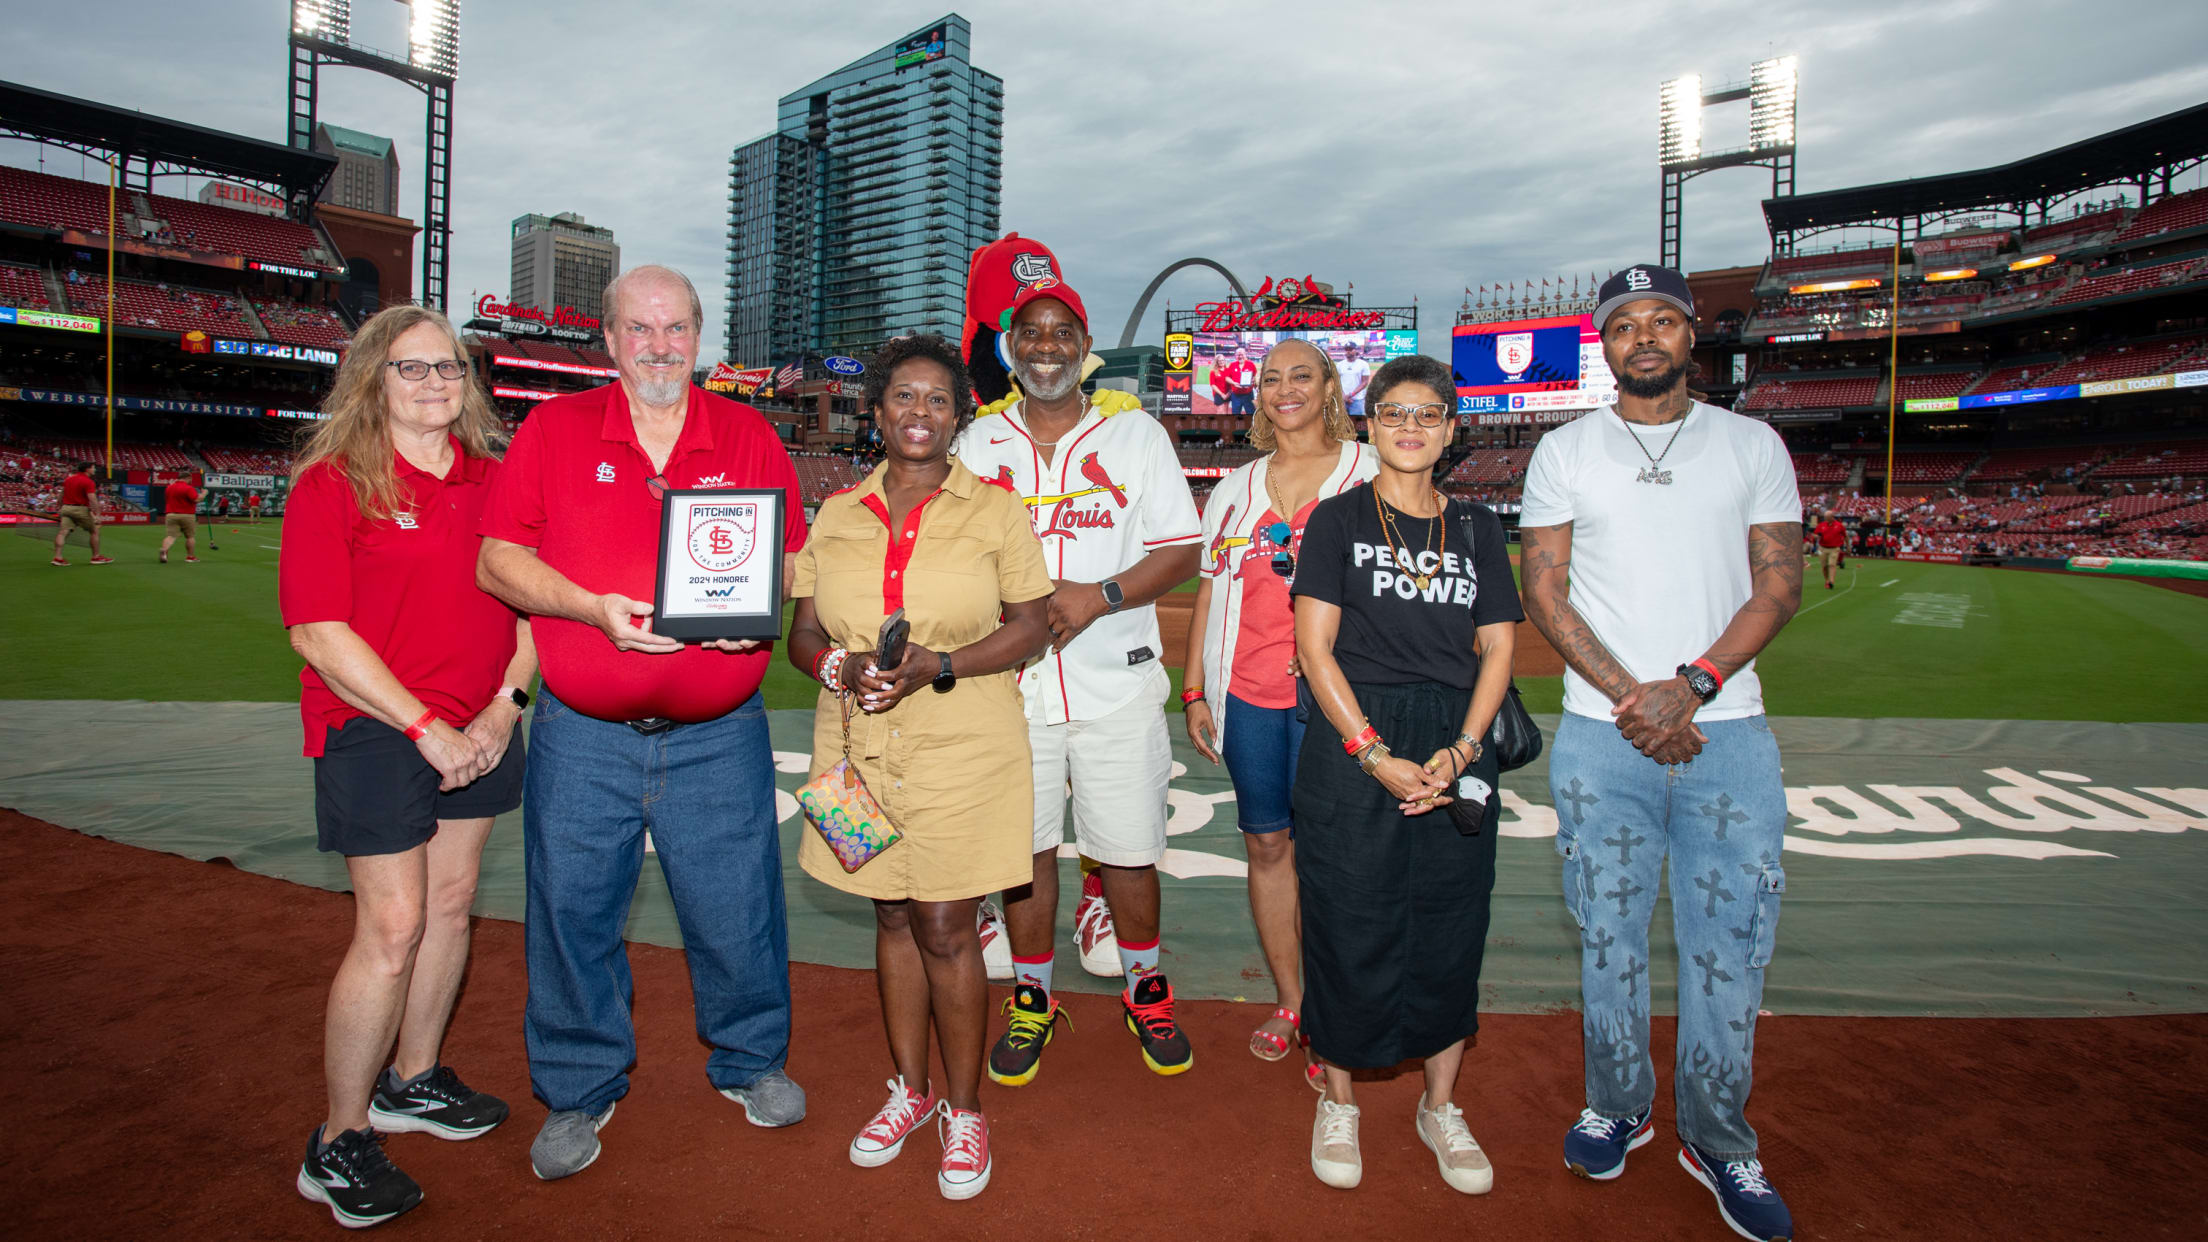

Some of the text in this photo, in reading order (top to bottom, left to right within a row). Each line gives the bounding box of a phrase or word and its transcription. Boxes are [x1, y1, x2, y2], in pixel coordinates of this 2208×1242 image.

[215, 183, 285, 210] Hilton
[1944, 214, 1997, 225] BUDWEISER
[1949, 235, 2005, 247] BUDWEISER
[260, 263, 318, 278] FOR THE LOU
[478, 294, 600, 329] Cardinals Nation
[1195, 301, 1385, 332] Budweiser
[1472, 299, 1599, 321] WORLD CHAMPIO
[501, 320, 540, 333] HOFFMANN
[552, 328, 590, 340] ROOFTOP
[1791, 334, 1807, 342] THE
[214, 340, 339, 365] BIG MAC LAND
[833, 358, 857, 371] Ford
[707, 366, 766, 383] Budweis
[704, 380, 774, 398] BREW HOE
[2083, 381, 2124, 394] ENROLL
[2126, 377, 2167, 390] TODAY!
[140, 399, 257, 416] UNIVERSITY
[1462, 395, 1499, 409] STIFEL
[277, 409, 296, 418] FOR
[297, 411, 316, 419] THE
[1479, 413, 1521, 425] BROWN
[1524, 415, 1532, 423] &
[221, 475, 273, 488] Ballpark
[693, 507, 743, 517] PITCHING
[1040, 497, 1115, 541] Louis
[1353, 542, 1460, 574] PEACE
[713, 576, 749, 584] HONOREE
